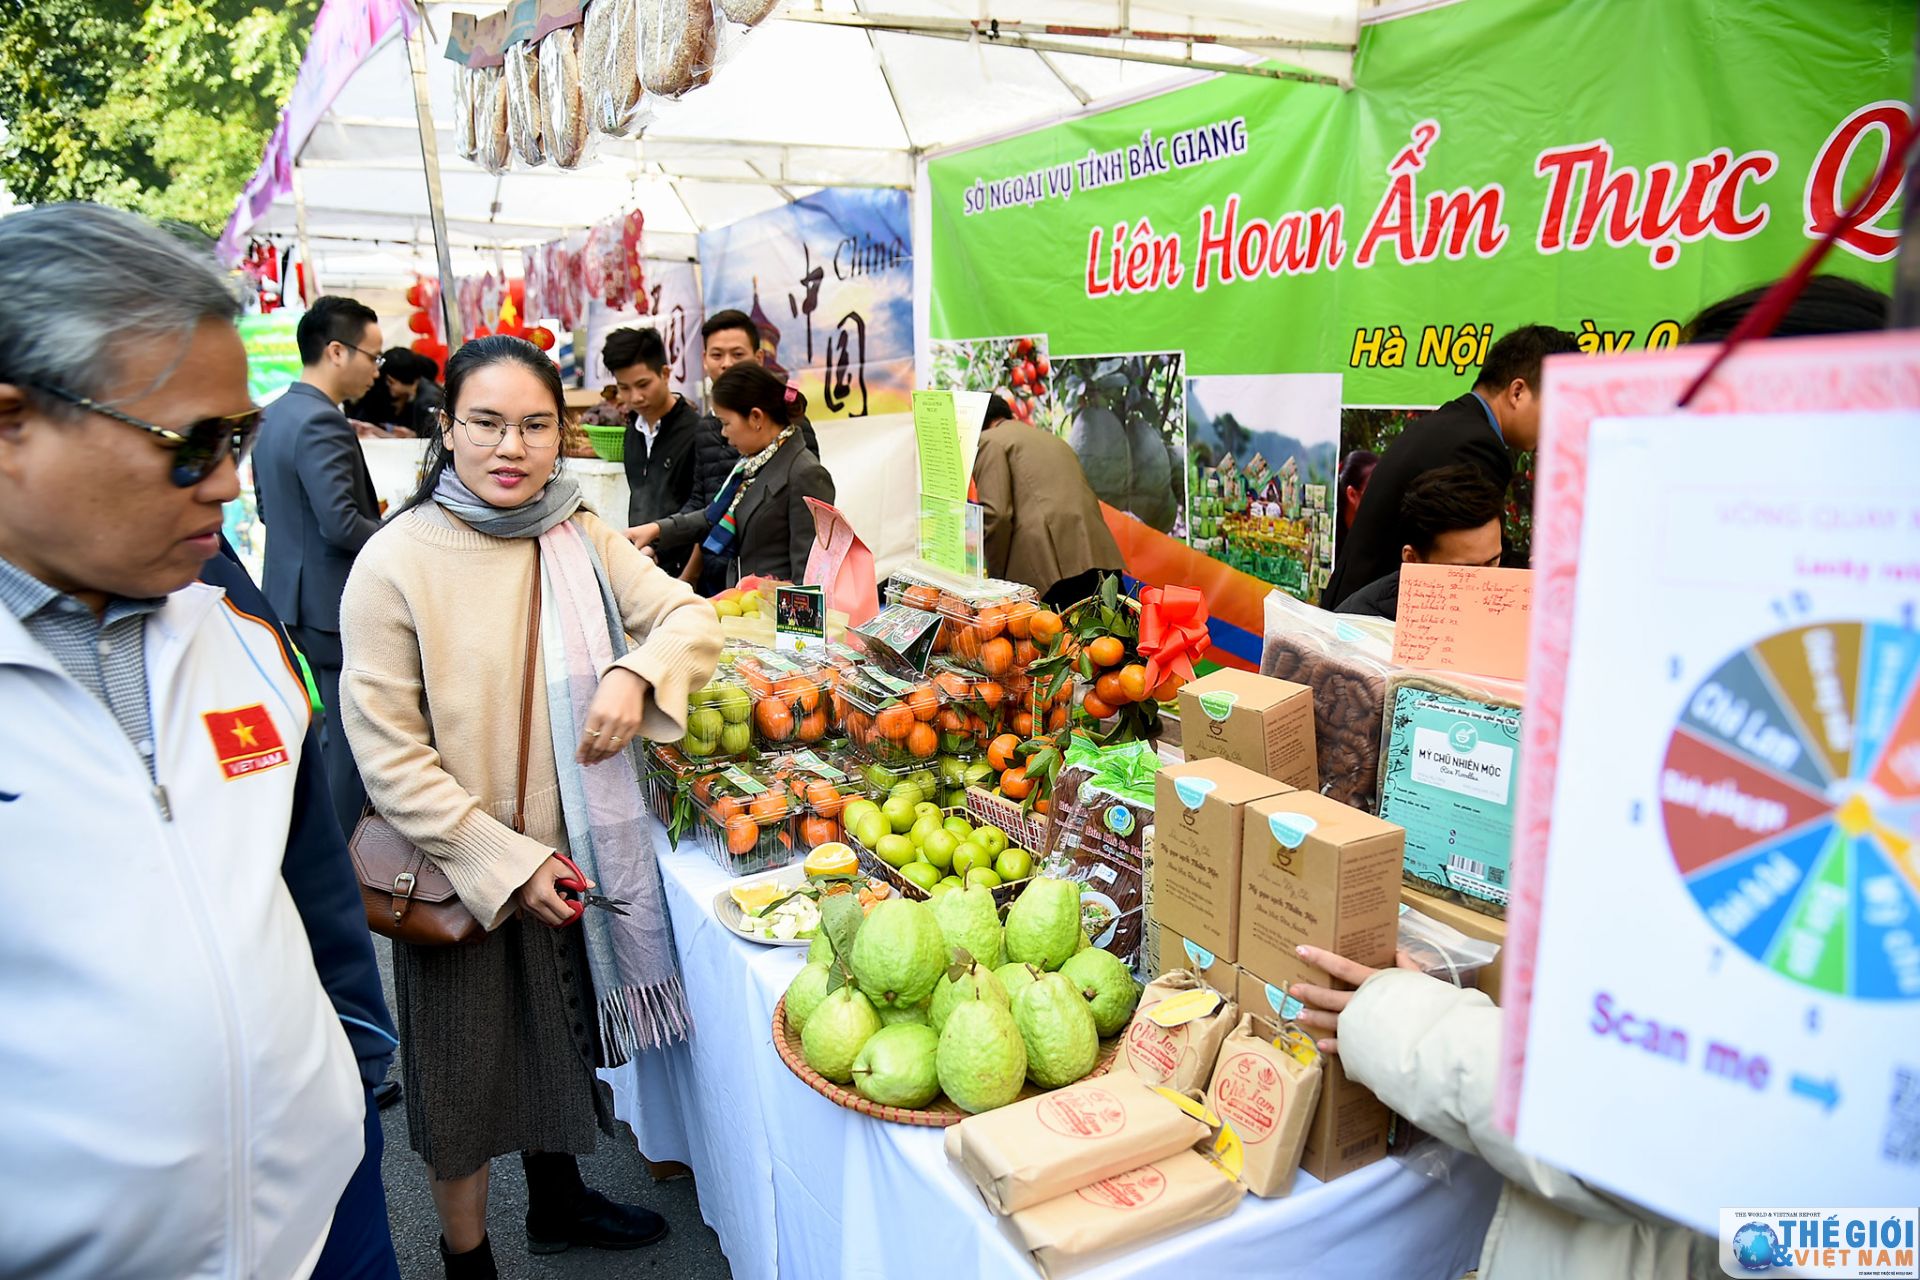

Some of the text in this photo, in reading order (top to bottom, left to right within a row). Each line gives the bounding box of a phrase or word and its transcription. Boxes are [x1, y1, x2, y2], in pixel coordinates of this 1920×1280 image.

[964, 179, 985, 215] SỞ
[989, 173, 1043, 209] NGOẠI
[1048, 166, 1072, 199] VỤ
[1128, 129, 1168, 179] BẮC
[1172, 118, 1247, 166] GIANG
[1087, 218, 1183, 298] Liên
[1194, 194, 1343, 291] Hoan
[1354, 119, 1508, 269] Ẩm
[1536, 139, 1778, 269] Thực
[833, 231, 903, 281] China
[1351, 327, 1404, 368] Hà
[1418, 323, 1491, 374] Nội
[1589, 991, 1771, 1094] Scan me
[1219, 1078, 1247, 1101] Chè
